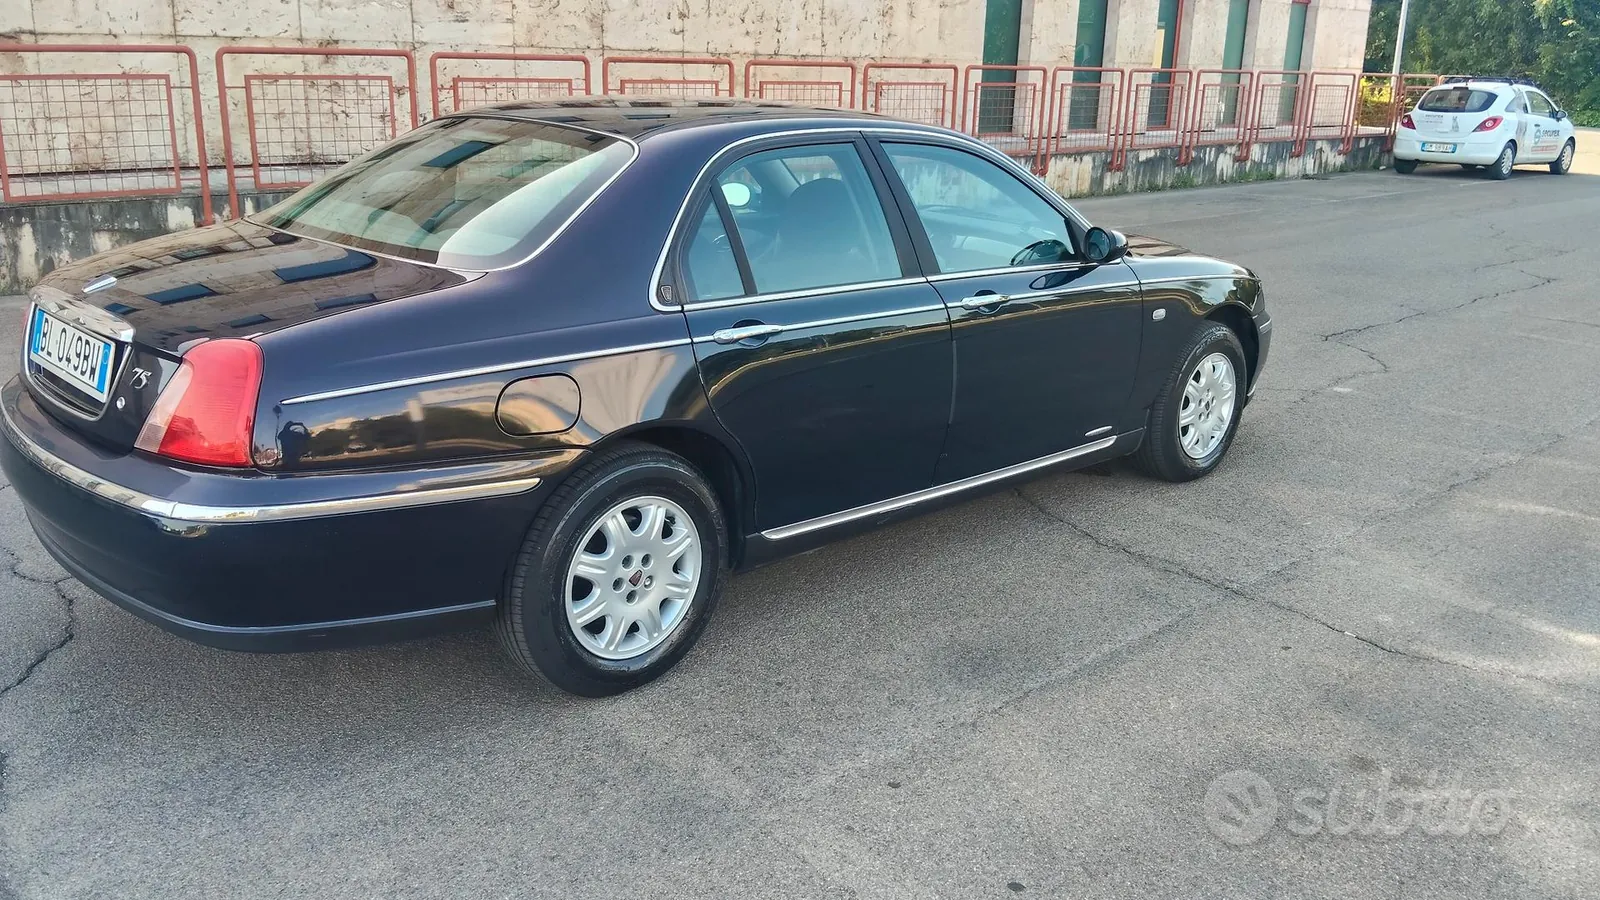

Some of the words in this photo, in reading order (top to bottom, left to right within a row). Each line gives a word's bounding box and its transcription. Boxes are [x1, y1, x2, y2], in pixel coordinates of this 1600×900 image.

[40, 317, 53, 358] BL
[57, 327, 101, 382] 049BW
[129, 367, 153, 389] 75
